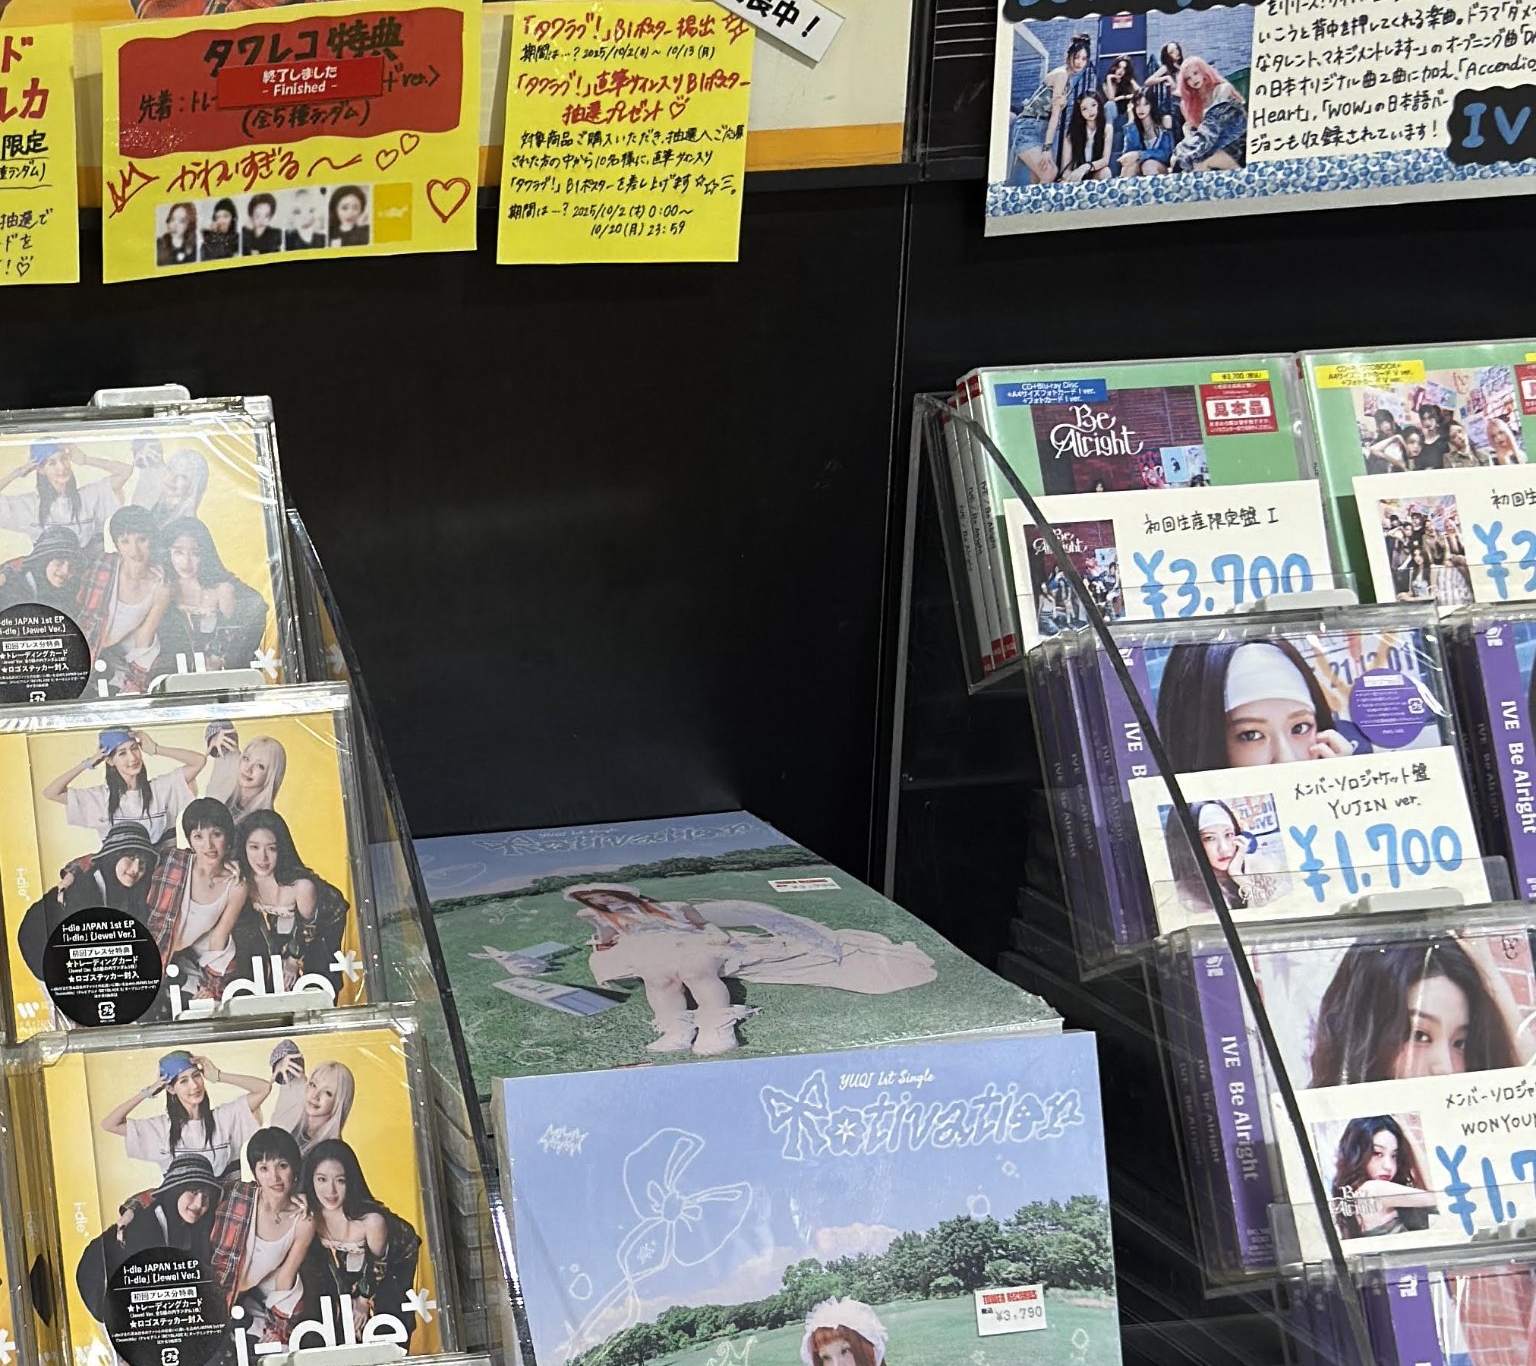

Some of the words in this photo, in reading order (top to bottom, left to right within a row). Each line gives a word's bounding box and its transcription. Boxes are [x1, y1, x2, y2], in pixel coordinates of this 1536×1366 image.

[263, 65, 337, 84] 終了しました
[273, 82, 326, 96] Finished
[1069, 404, 1115, 430] Be
[1050, 424, 1144, 459] Alright
[1501, 700, 1520, 731] IVE
[1123, 722, 1143, 752] IVE
[1507, 741, 1526, 765] Be
[1327, 796, 1387, 820] YUJIN
[1394, 796, 1421, 809] ver.
[1221, 1036, 1241, 1068] IVE
[1229, 1081, 1246, 1106] Be
[1233, 1111, 1259, 1181] Alright
[982, 1293, 1006, 1305] TOWER
[1006, 1290, 1038, 1303] RECORDS
